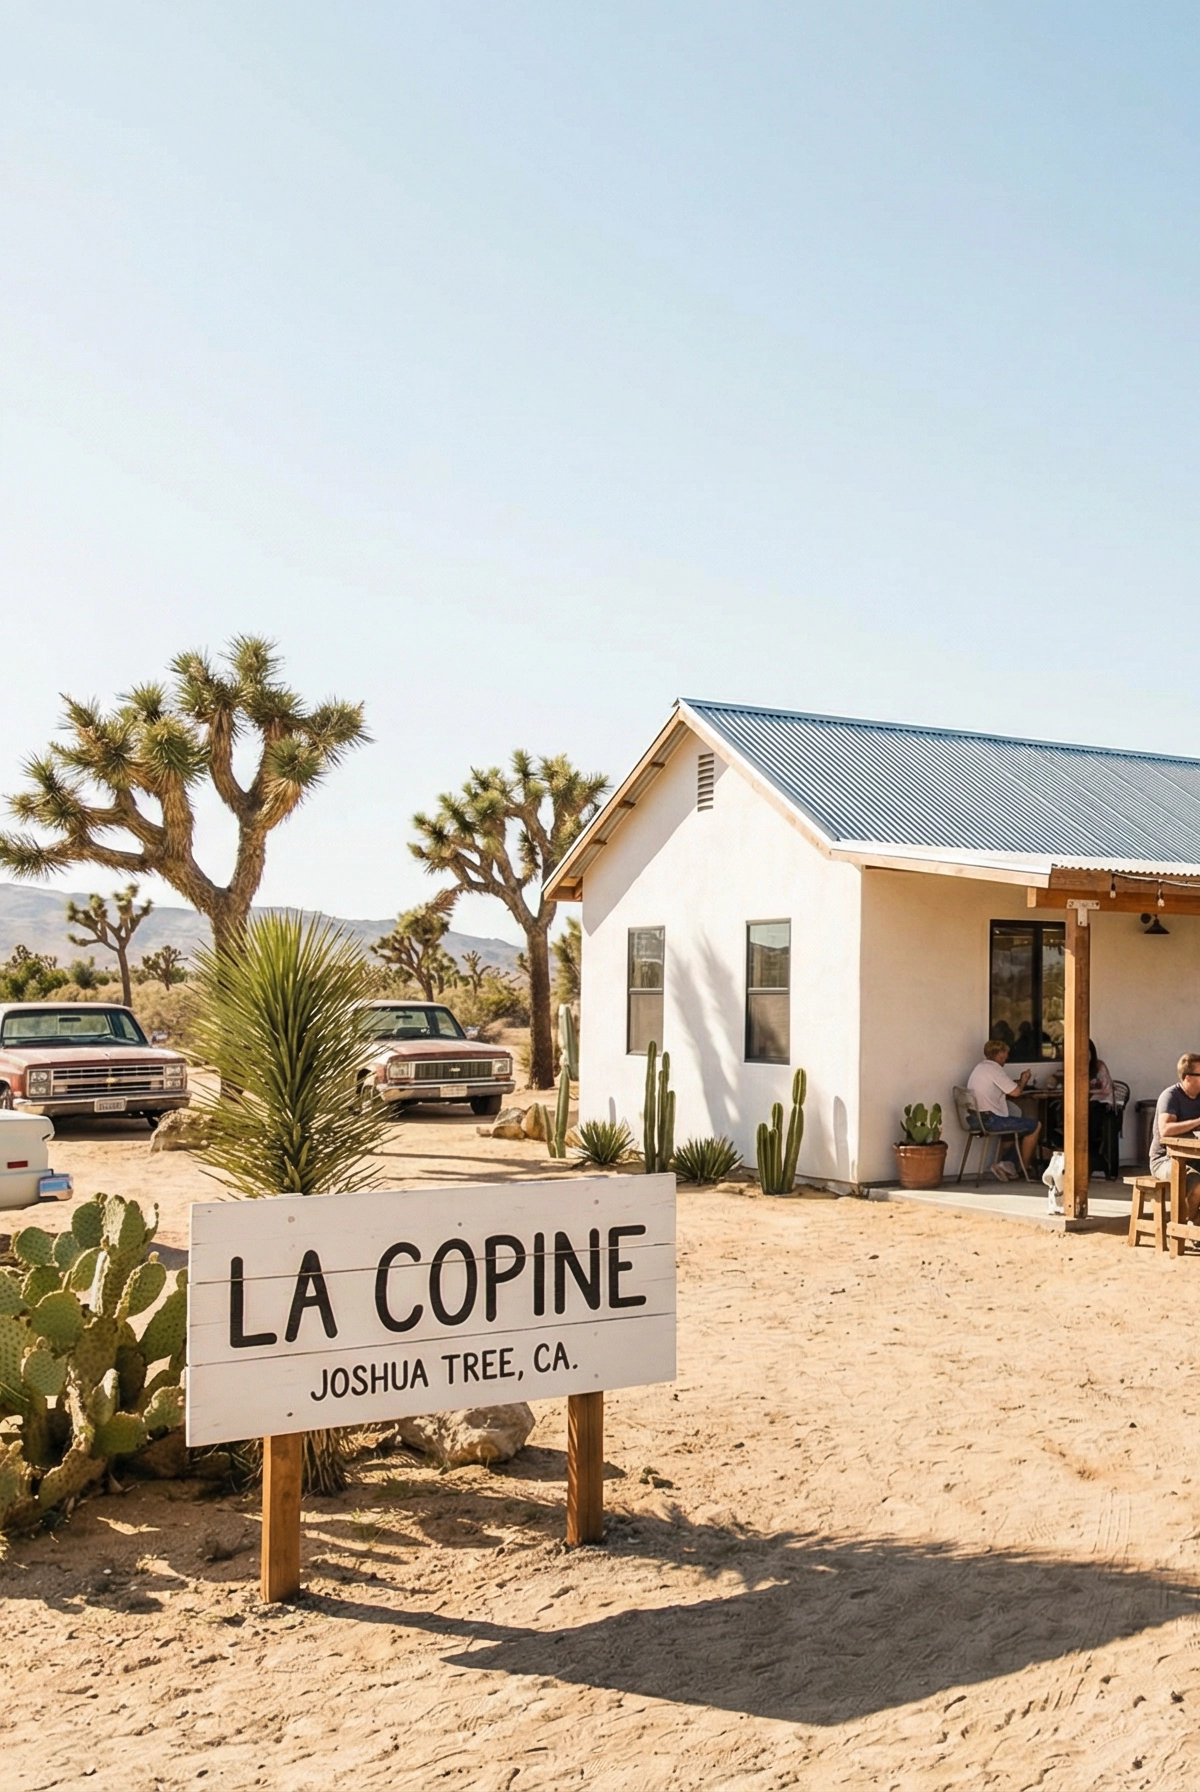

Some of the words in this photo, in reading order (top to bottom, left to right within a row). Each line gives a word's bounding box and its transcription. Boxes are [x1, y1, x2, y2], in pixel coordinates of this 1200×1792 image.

[229, 1249, 338, 1349] LA
[374, 1224, 647, 1333] COPINE
[310, 1358, 429, 1402] JOSHUA
[440, 1347, 524, 1385] TREE,
[533, 1341, 578, 1373] CA.
